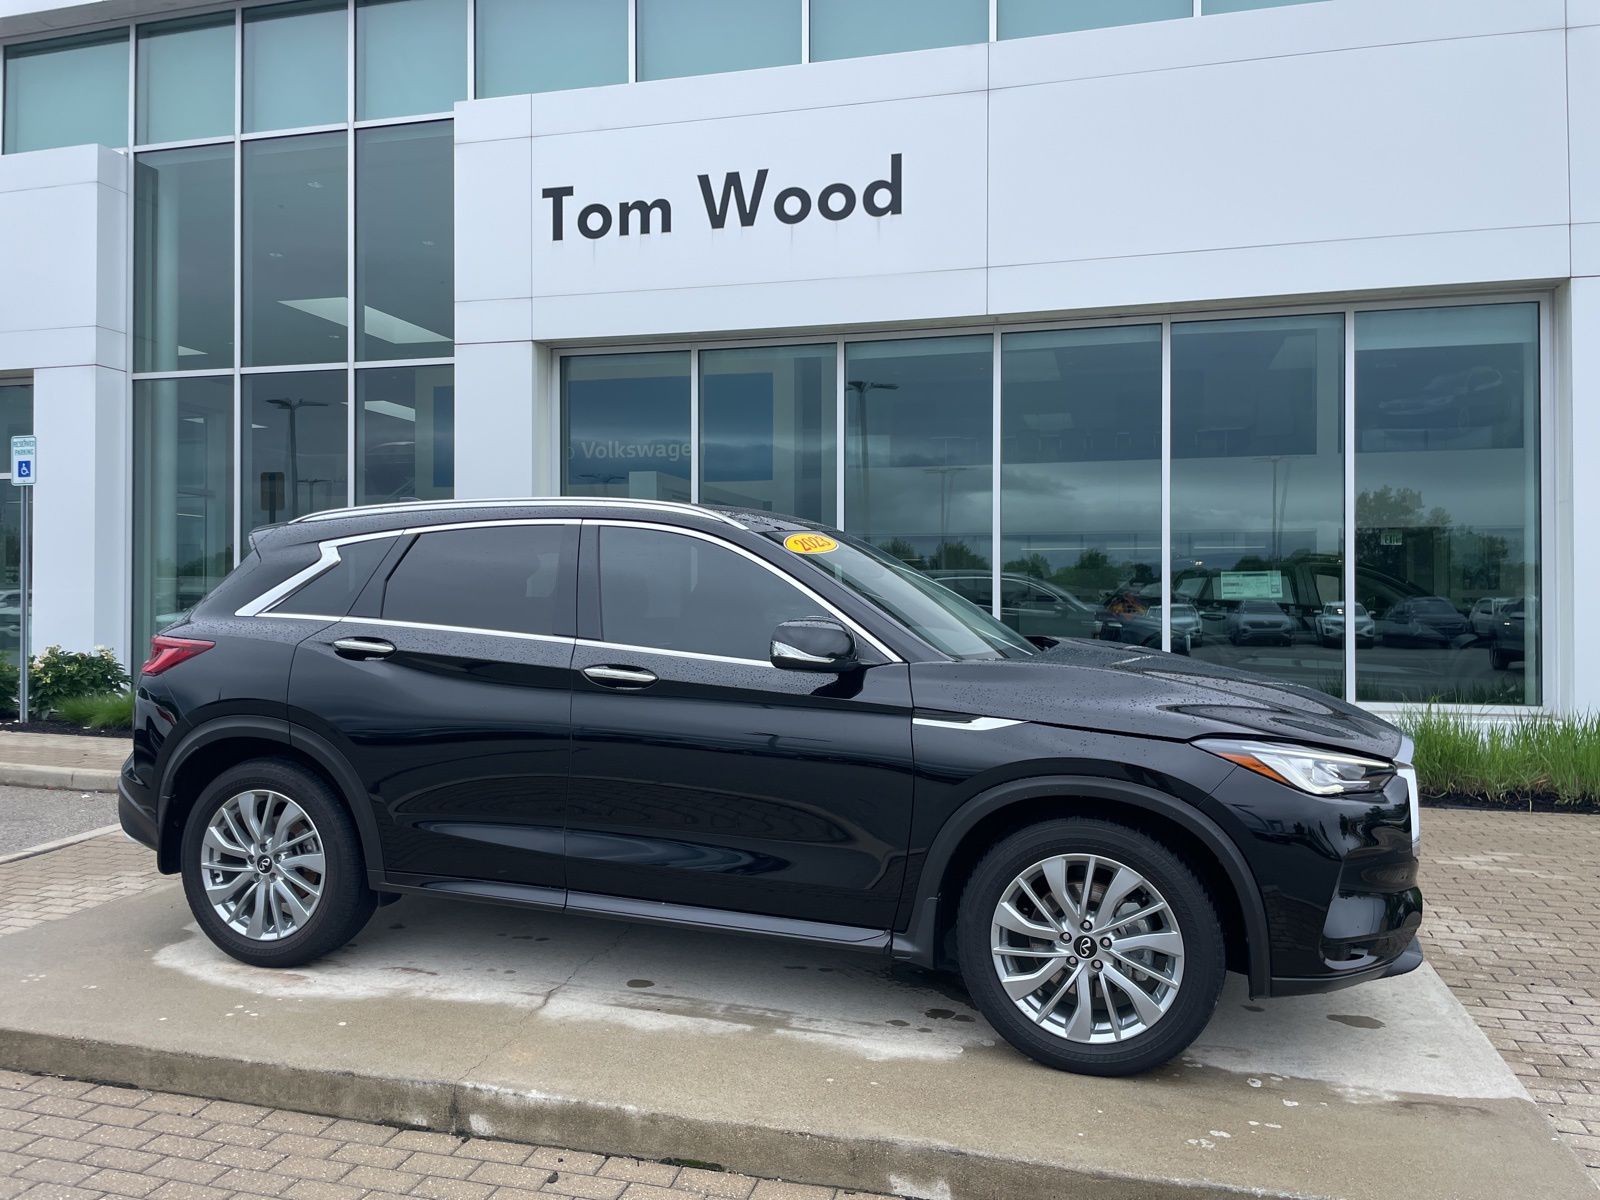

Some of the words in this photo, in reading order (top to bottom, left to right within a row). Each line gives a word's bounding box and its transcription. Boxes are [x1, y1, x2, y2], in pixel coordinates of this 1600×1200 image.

[542, 186, 672, 241] Tom
[697, 153, 902, 229] Wood
[581, 440, 705, 462] Volkswage
[794, 536, 831, 551] 2023
